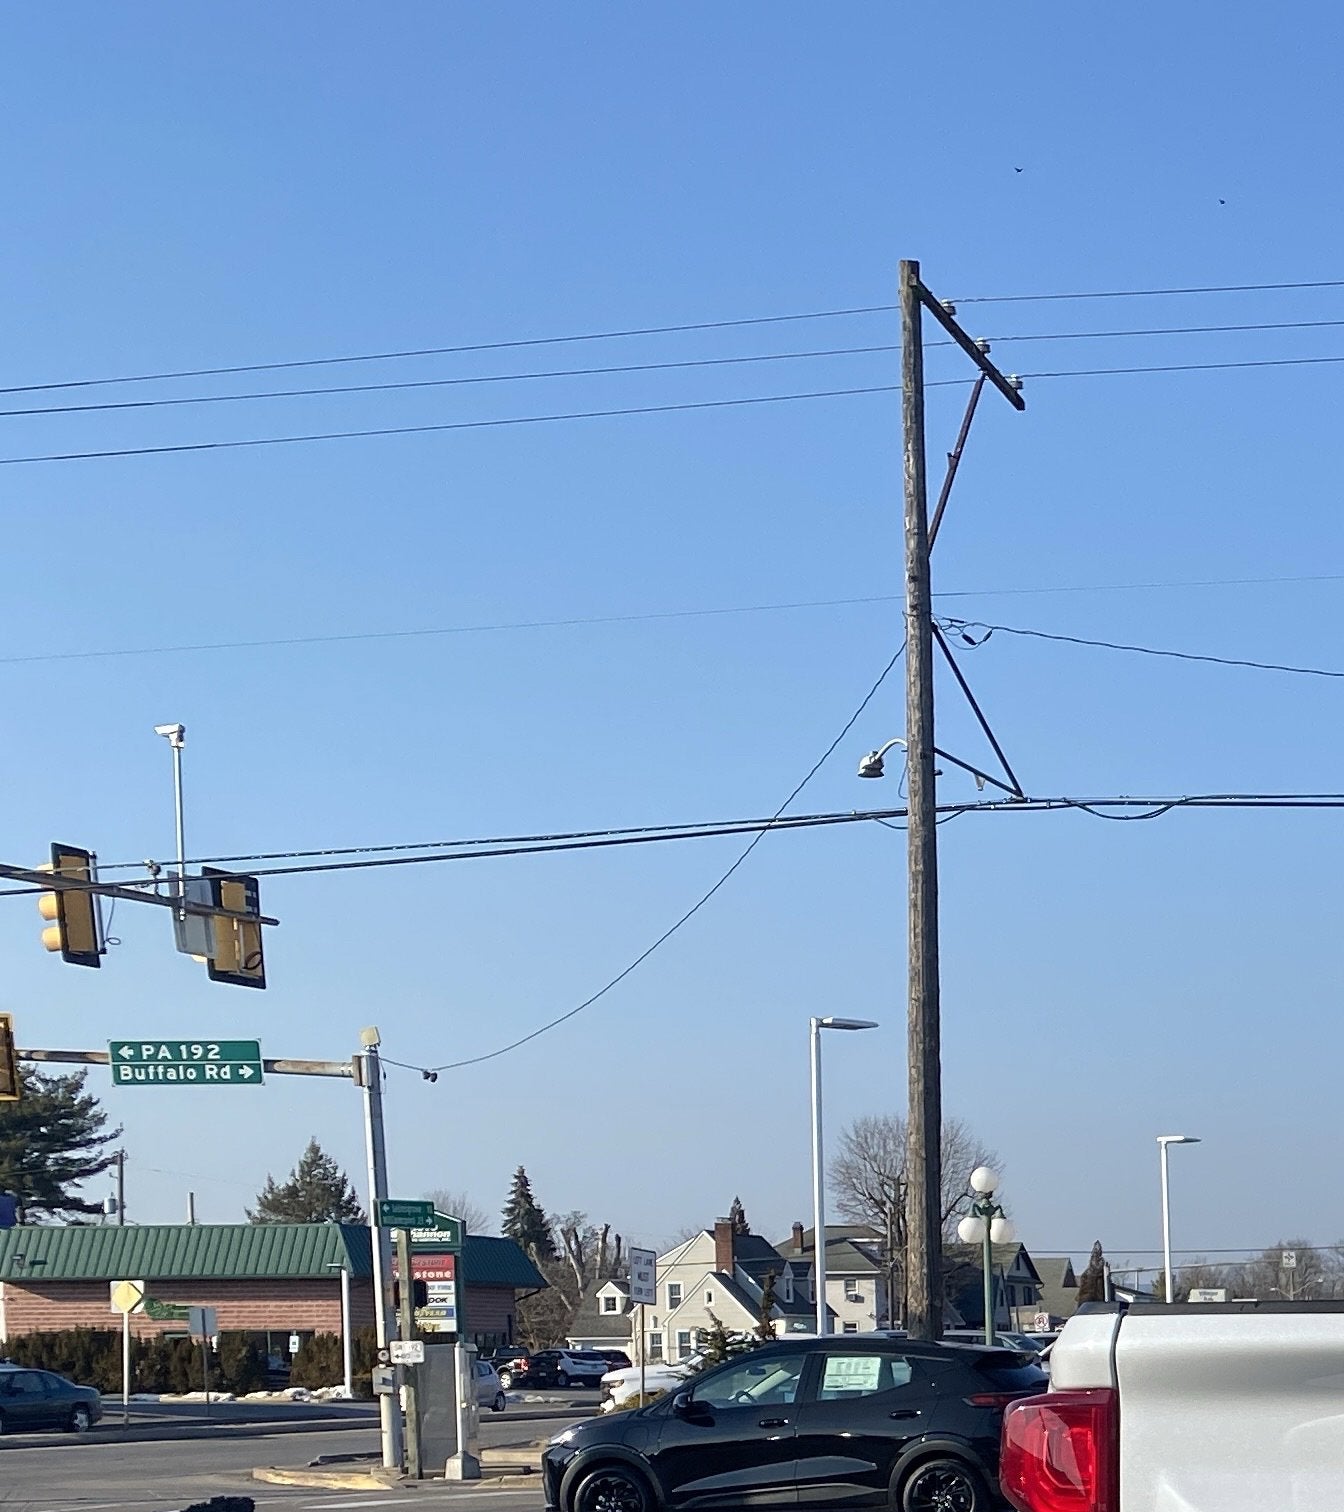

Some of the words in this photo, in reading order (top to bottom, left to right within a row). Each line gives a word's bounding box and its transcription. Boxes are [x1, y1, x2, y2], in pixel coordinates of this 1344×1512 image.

[141, 1044, 172, 1060] PA
[180, 1044, 221, 1060] 192
[119, 1065, 197, 1080] Buffalo
[204, 1065, 232, 1080] Rd
